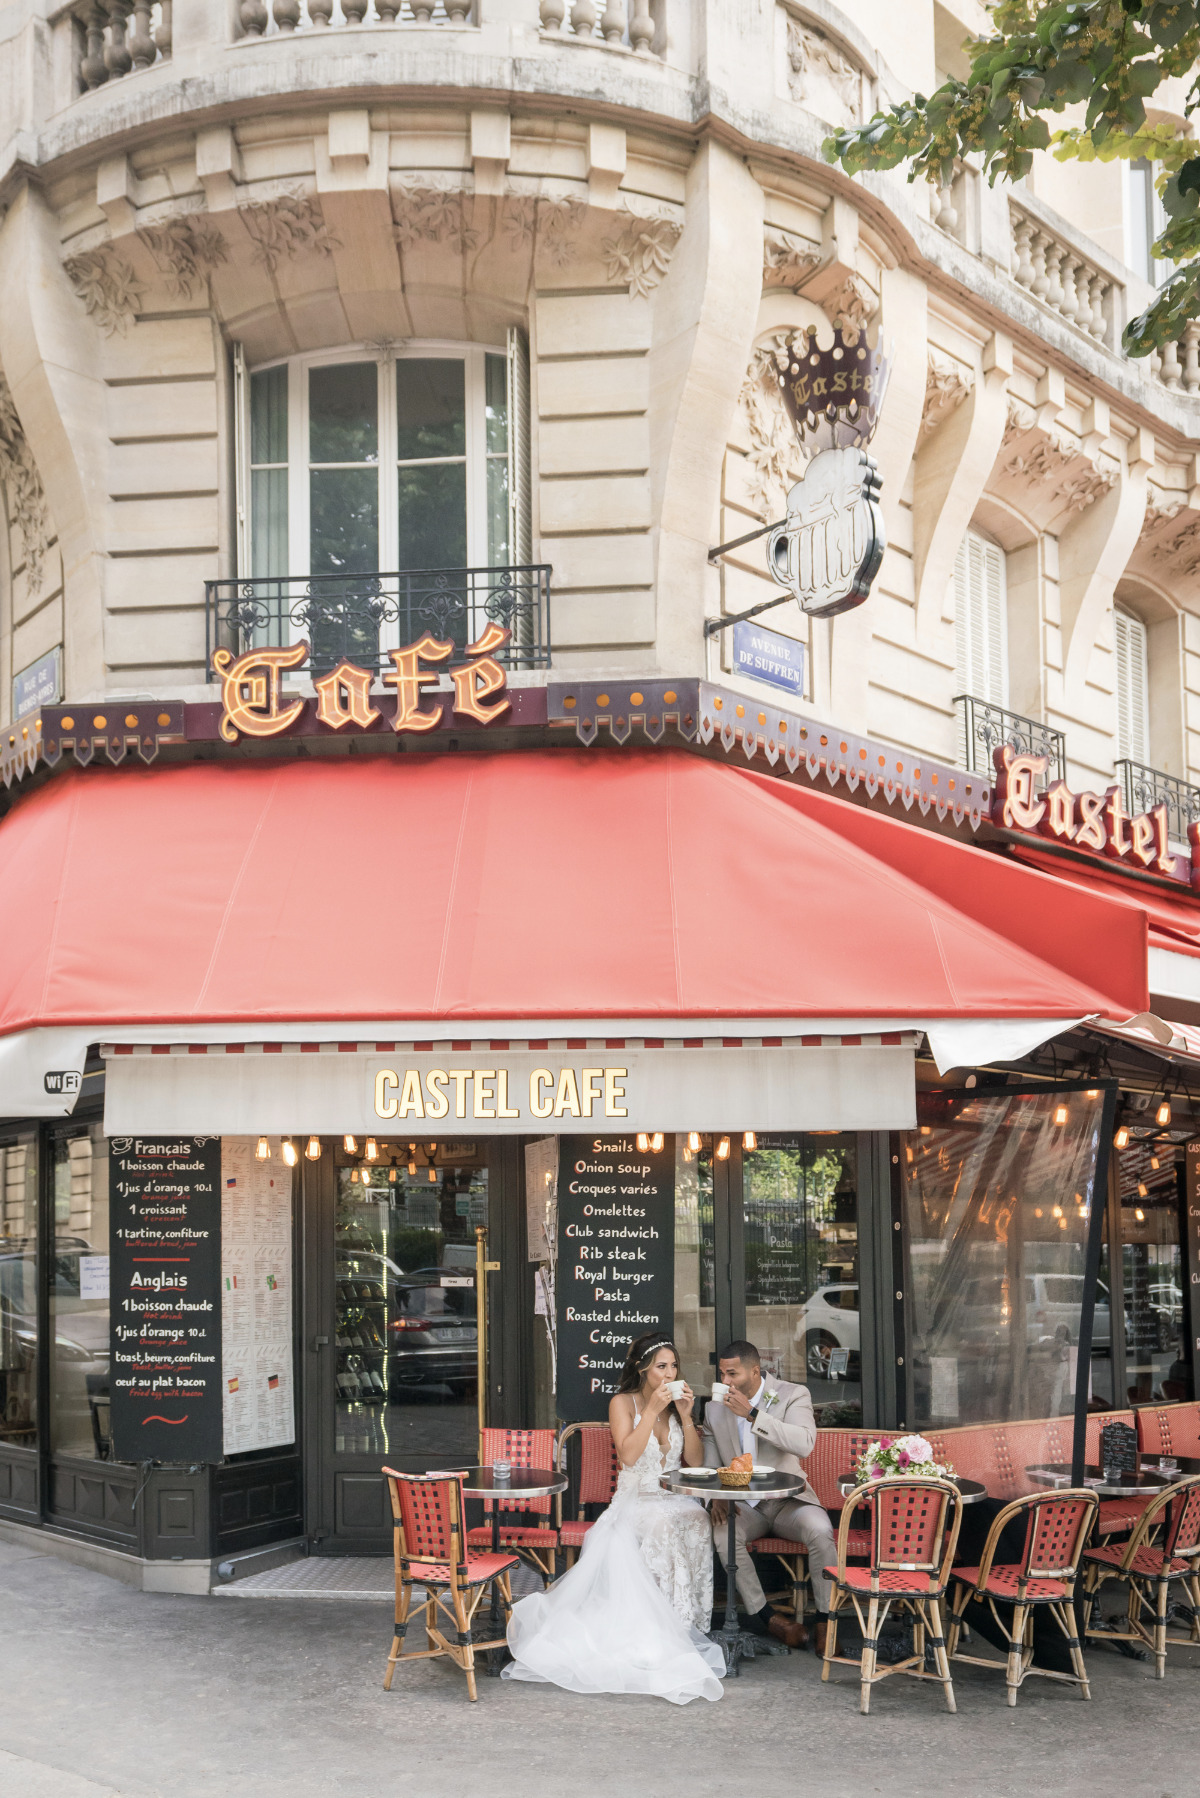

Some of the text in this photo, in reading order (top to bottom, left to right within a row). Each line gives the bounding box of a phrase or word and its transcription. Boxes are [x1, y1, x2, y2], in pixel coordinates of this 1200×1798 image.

[751, 637, 791, 661] AVENUE
[739, 650, 800, 683] DE SUFFREN
[374, 1067, 628, 1119] CASTEL CAFE
[135, 1140, 191, 1156] Français
[592, 1139, 634, 1153] Snails
[167, 1160, 205, 1170] chaude
[574, 1160, 651, 1178] Onion soup
[569, 1181, 658, 1197] Croques variés
[129, 1203, 187, 1215] 1 croissant
[583, 1203, 646, 1217] Omelettes
[565, 1224, 659, 1239] Club sandwich
[770, 1235, 793, 1248] Pasta
[580, 1246, 647, 1260] Rib steak
[130, 1271, 188, 1292] Anglais
[574, 1265, 655, 1285] Royal burger
[594, 1287, 630, 1302] Pasta
[175, 1299, 213, 1311] chaude
[566, 1306, 659, 1324] Roasted chicken
[589, 1329, 633, 1347] Crêpes
[152, 1376, 173, 1391] plat
[176, 1376, 206, 1386] bacon
[129, 1388, 204, 1400] Fried egg with bacon
